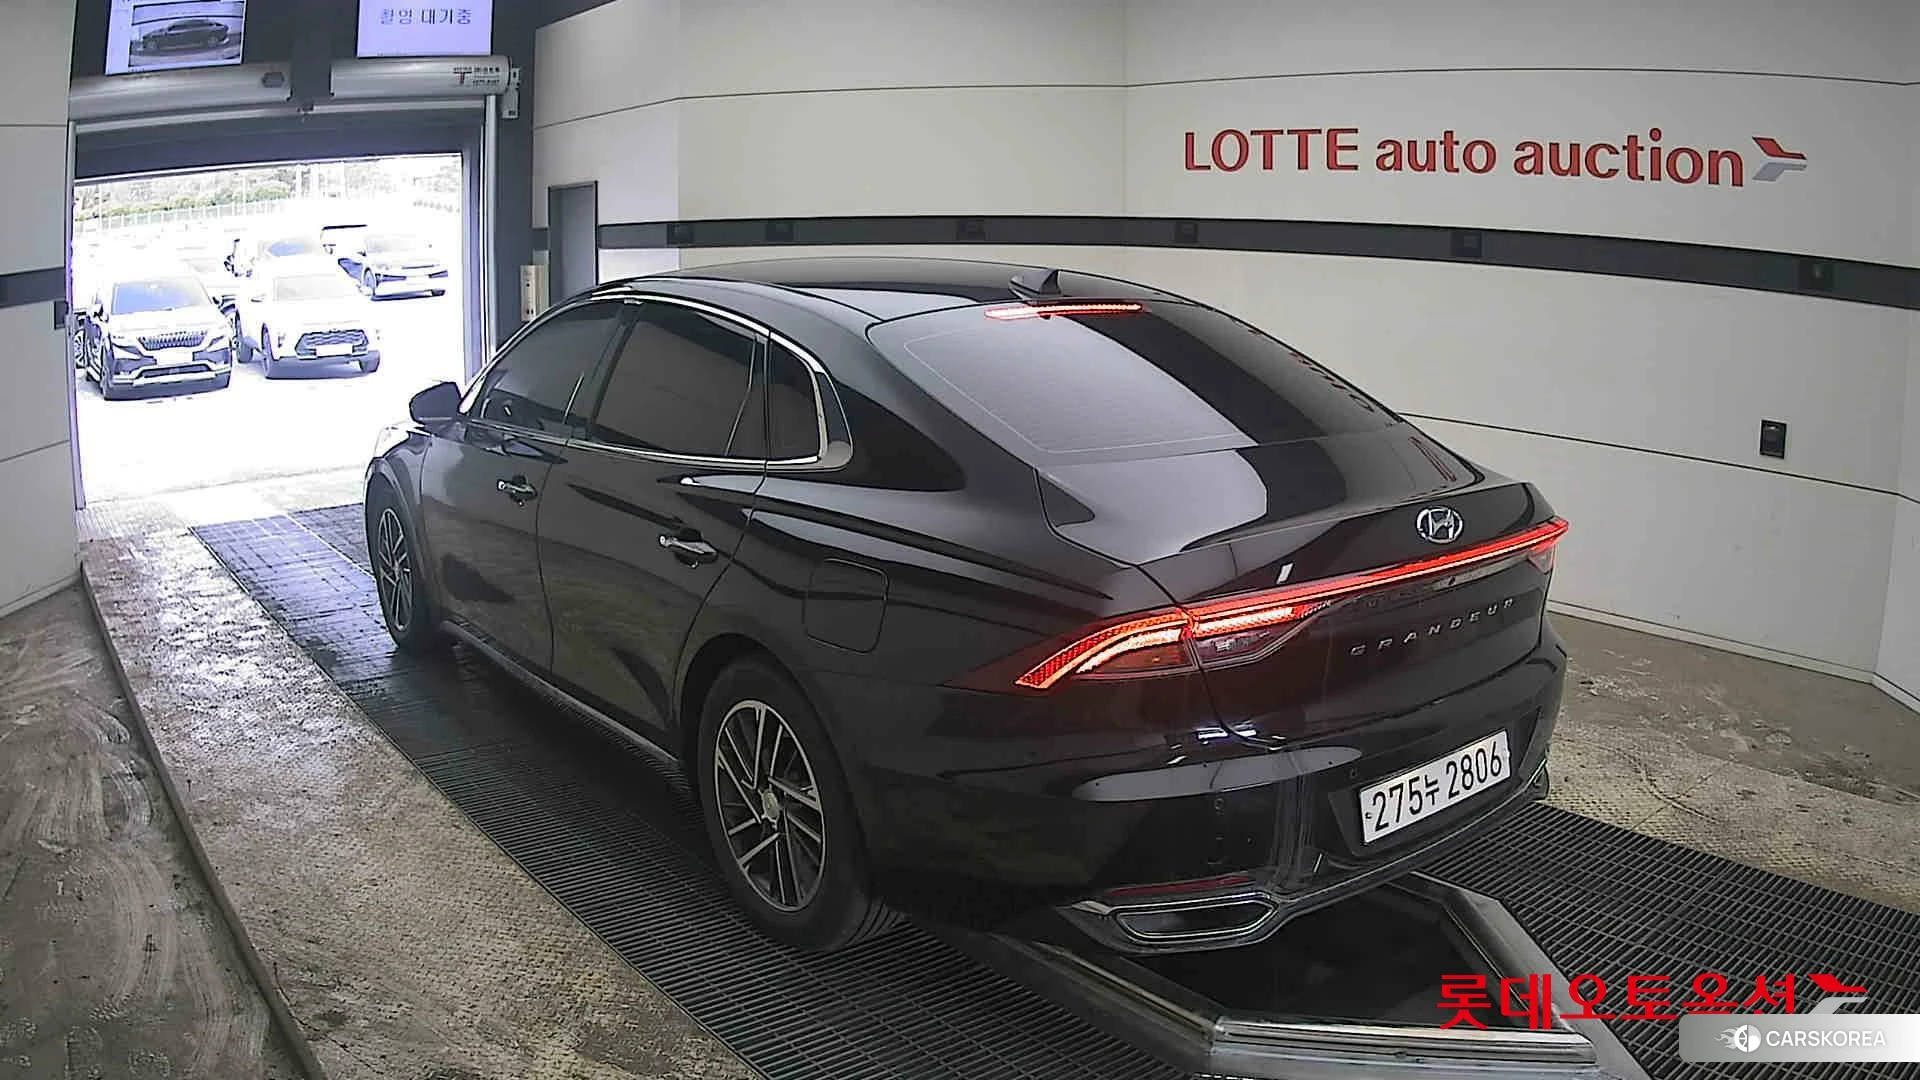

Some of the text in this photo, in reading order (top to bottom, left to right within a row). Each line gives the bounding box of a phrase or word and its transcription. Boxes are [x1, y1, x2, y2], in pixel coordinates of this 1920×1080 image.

[421, 8, 472, 25] 대기중
[1184, 128, 1744, 187] LOTTE auto auction
[1351, 598, 1514, 656] GRANDEUR
[1372, 740, 1502, 832] 275누 2806
